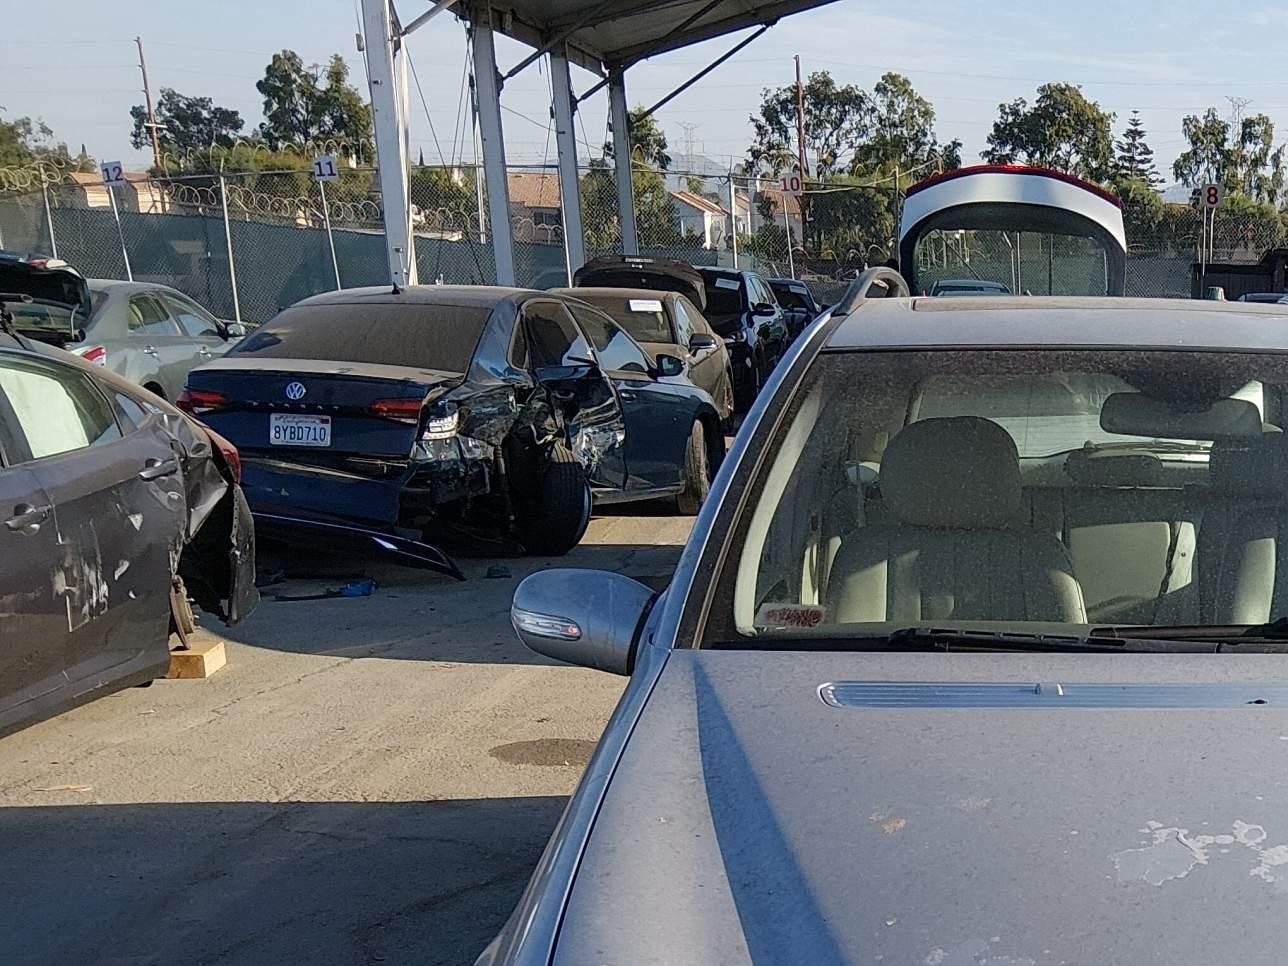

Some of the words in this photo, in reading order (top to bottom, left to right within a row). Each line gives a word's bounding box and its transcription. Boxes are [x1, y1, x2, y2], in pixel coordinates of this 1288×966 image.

[102, 165, 123, 183] 12
[314, 160, 337, 178] 11
[779, 176, 800, 192] 10
[1206, 186, 1219, 205] 8
[273, 424, 327, 442] 8YBD710
